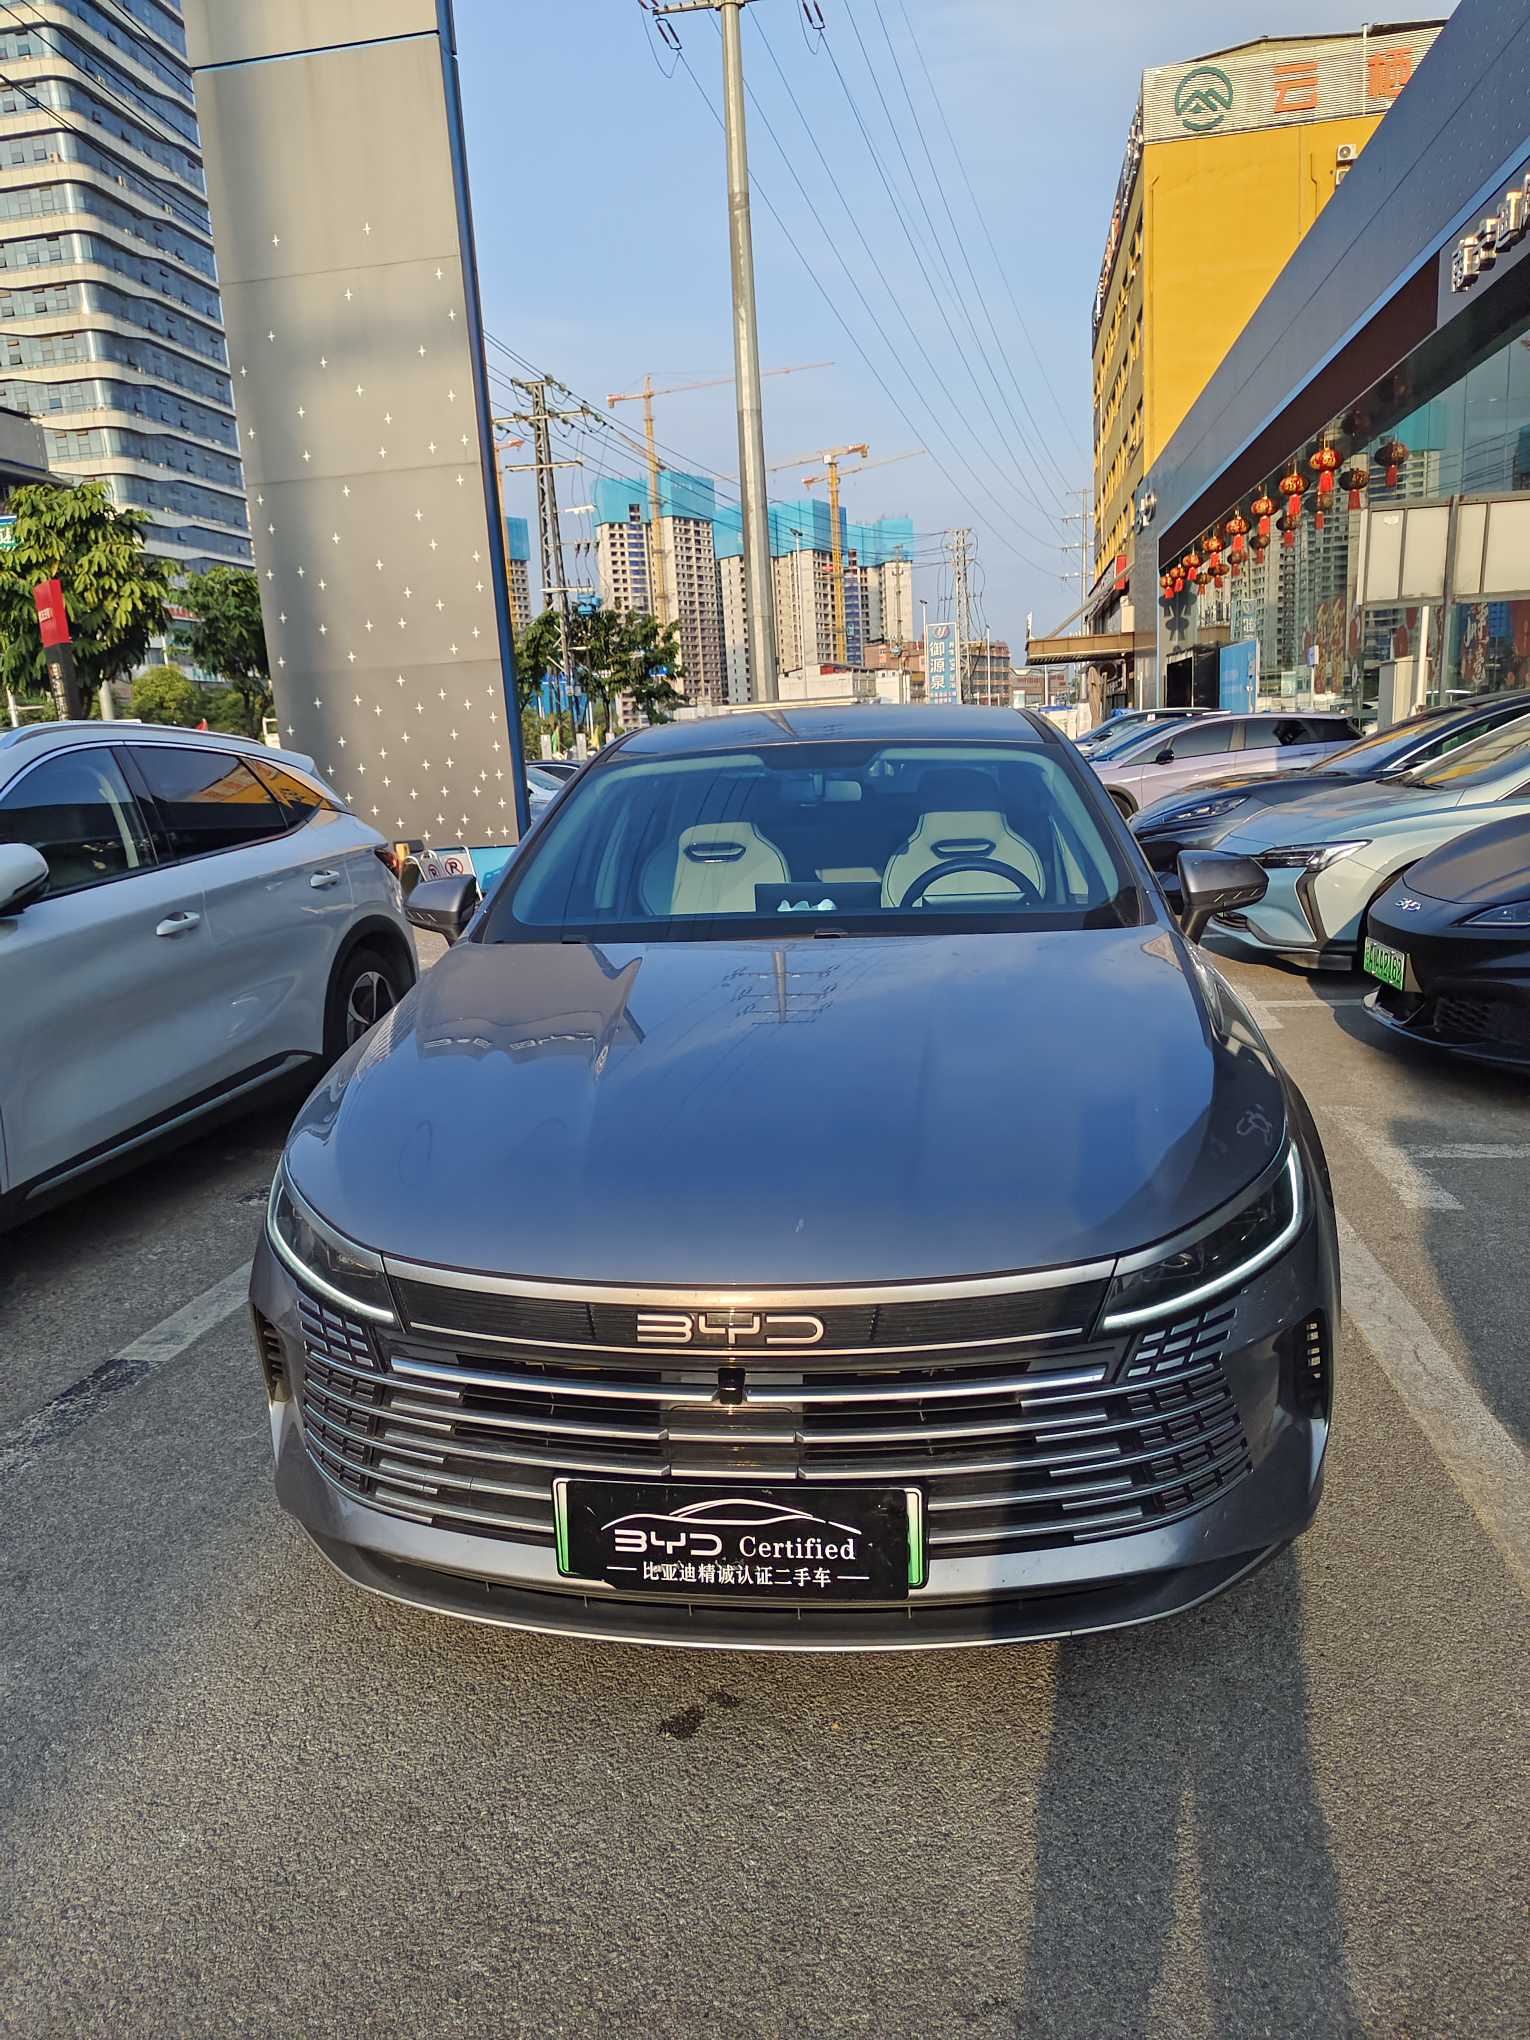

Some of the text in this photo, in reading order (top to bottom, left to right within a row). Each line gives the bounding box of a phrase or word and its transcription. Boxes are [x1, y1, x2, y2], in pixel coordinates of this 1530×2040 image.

[929, 641, 945, 689] 御源泉
[637, 1313, 825, 1344] BYD
[614, 1529, 856, 1560] BYD Certified
[642, 1561, 832, 1588] 比亚迪精诚认证二手车
